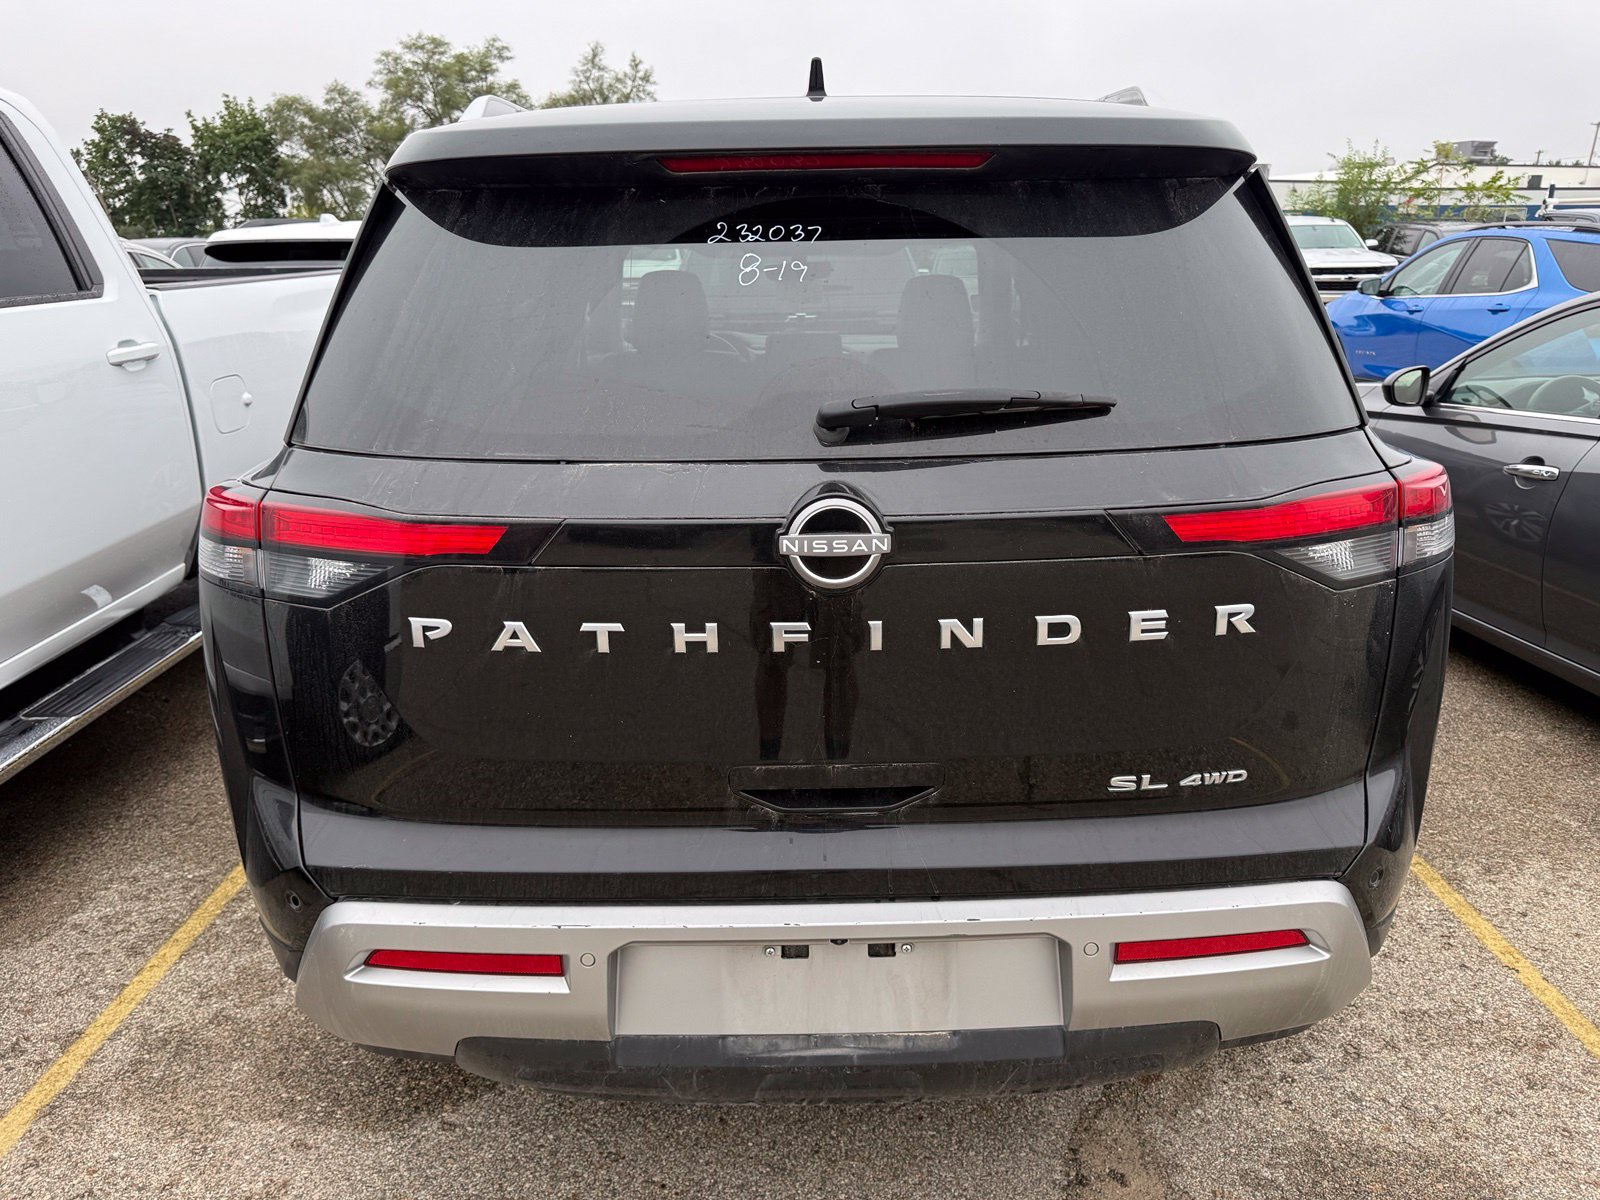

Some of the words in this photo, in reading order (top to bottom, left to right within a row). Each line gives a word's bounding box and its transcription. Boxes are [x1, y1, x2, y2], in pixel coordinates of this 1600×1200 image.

[707, 221, 822, 244] 232037
[738, 252, 808, 286] 8-19
[782, 537, 888, 553] NISSAN
[407, 603, 1256, 654] PATHFINDER
[1106, 774, 1169, 793] SL
[1179, 769, 1248, 787] 4WD
